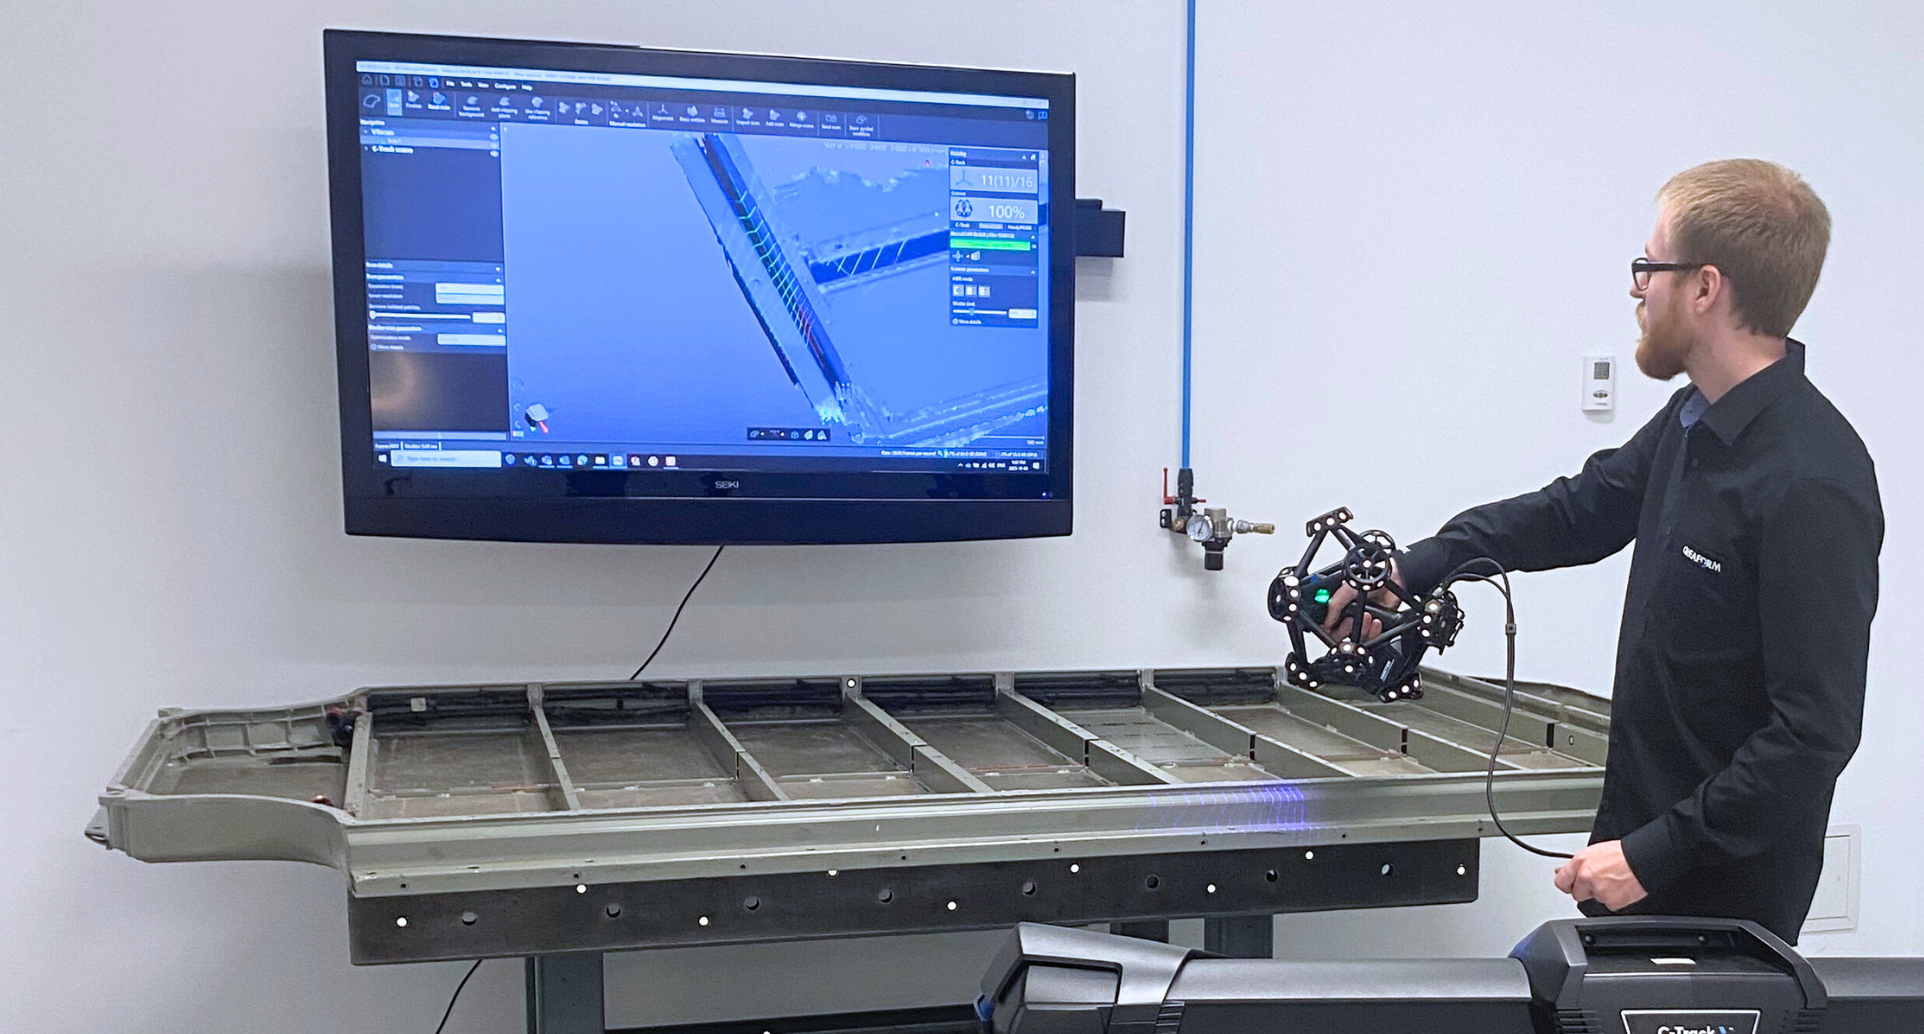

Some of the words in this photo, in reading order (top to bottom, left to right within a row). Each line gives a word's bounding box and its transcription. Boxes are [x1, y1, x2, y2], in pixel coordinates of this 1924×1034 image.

[982, 174, 1033, 188] 11(11)/16
[989, 205, 1025, 219] 100%
[715, 481, 739, 489] SEIKI
